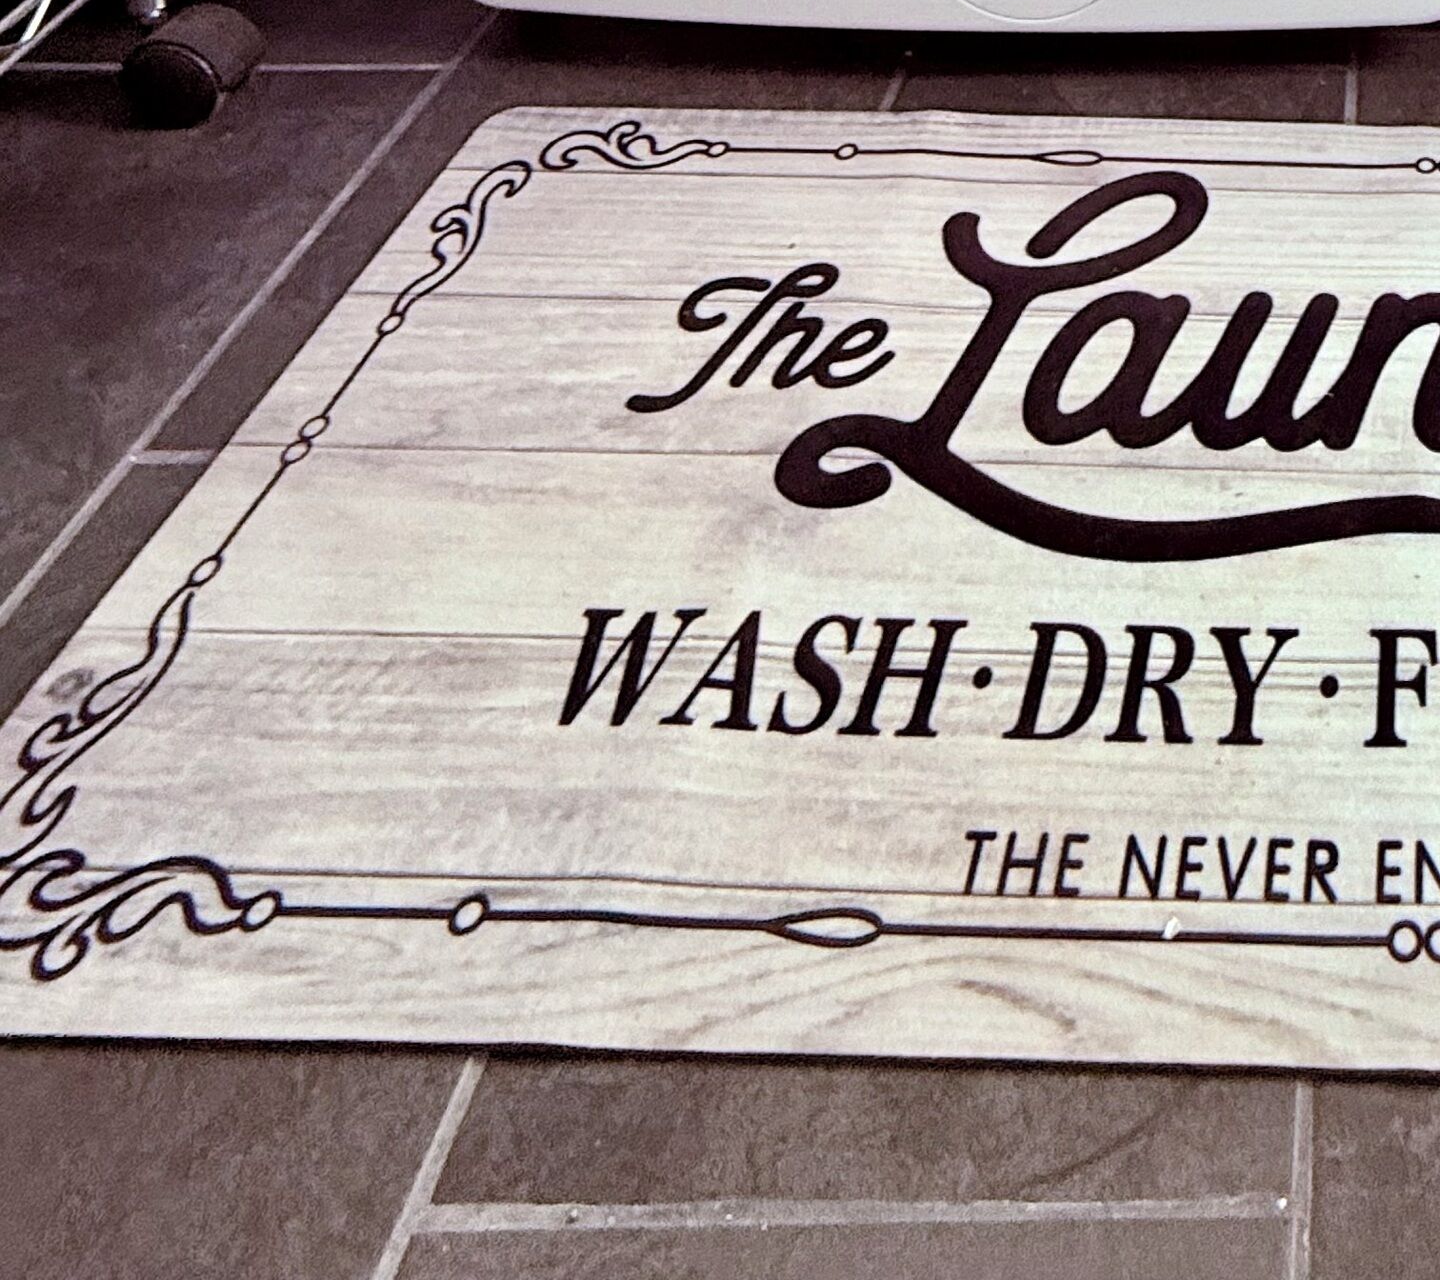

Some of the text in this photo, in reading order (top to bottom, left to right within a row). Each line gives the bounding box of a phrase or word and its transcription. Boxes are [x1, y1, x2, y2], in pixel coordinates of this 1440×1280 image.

[627, 262, 897, 415] The
[558, 607, 969, 738] WASH
[1002, 621, 1300, 746] DRY
[963, 830, 1091, 897] THE
[1117, 833, 1341, 905] NEVER
